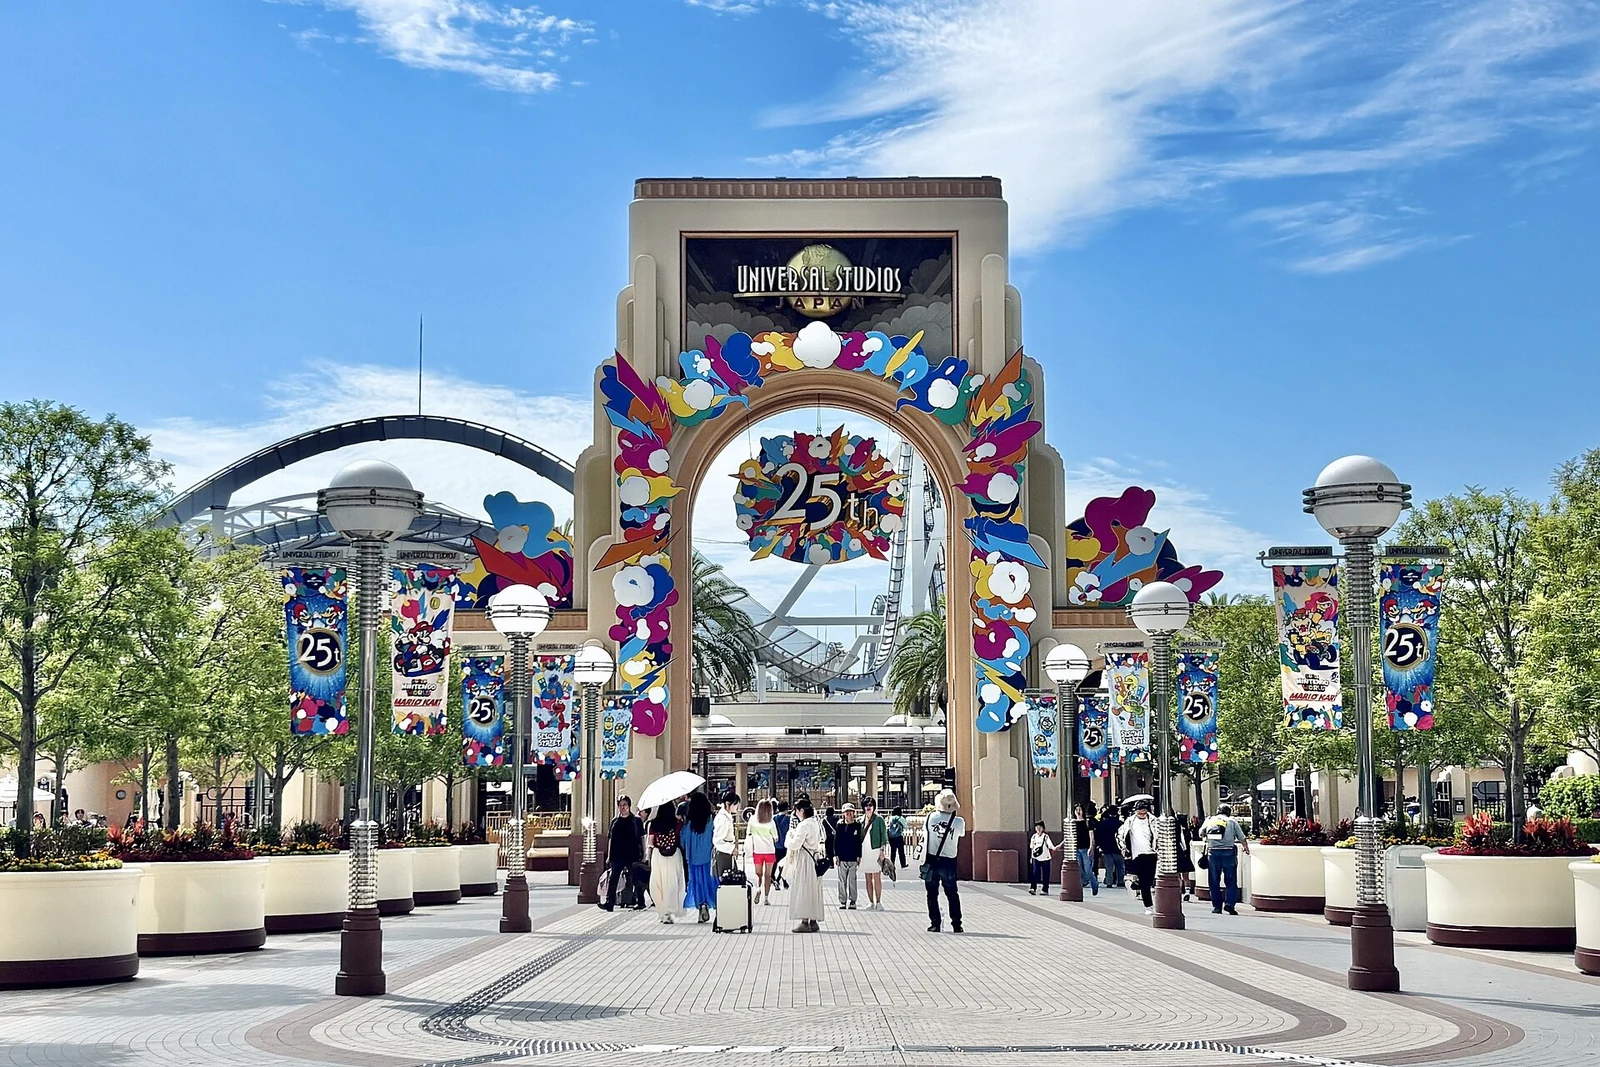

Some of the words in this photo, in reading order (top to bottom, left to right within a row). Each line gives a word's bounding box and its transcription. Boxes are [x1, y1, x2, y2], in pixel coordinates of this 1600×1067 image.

[737, 265, 829, 293] UNIVERSAL
[835, 265, 902, 293] STUDIOS
[775, 297, 865, 310] JAPAN
[768, 462, 879, 530] 25th
[296, 633, 342, 667] 25t
